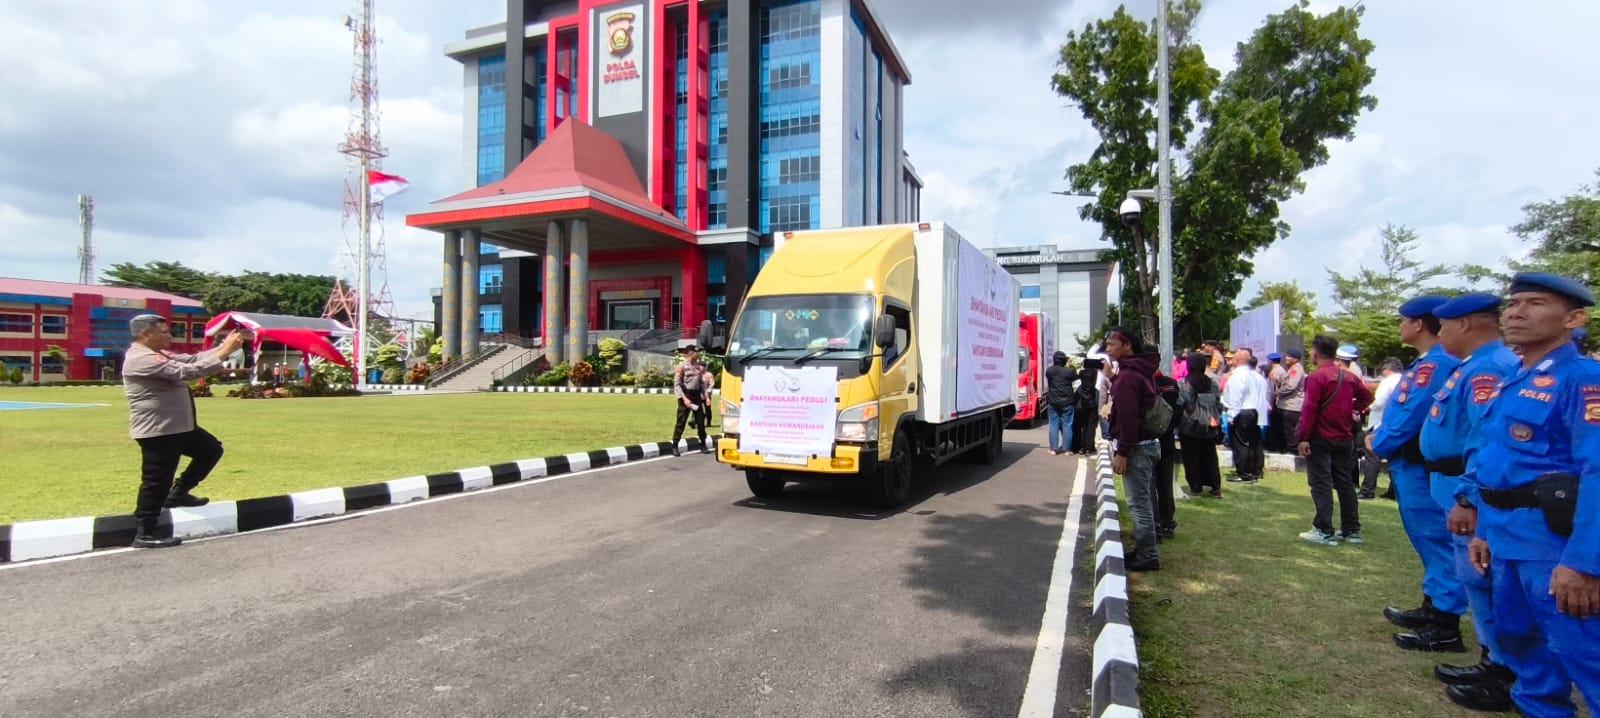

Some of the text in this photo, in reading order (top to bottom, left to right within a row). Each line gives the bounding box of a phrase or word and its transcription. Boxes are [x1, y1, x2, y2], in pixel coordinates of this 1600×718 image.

[607, 60, 636, 72] POLDA
[750, 394, 828, 404] BHAYANGKARI PEDULI
[1518, 389, 1551, 402] POLRI
[750, 420, 777, 428] BANTUAN
